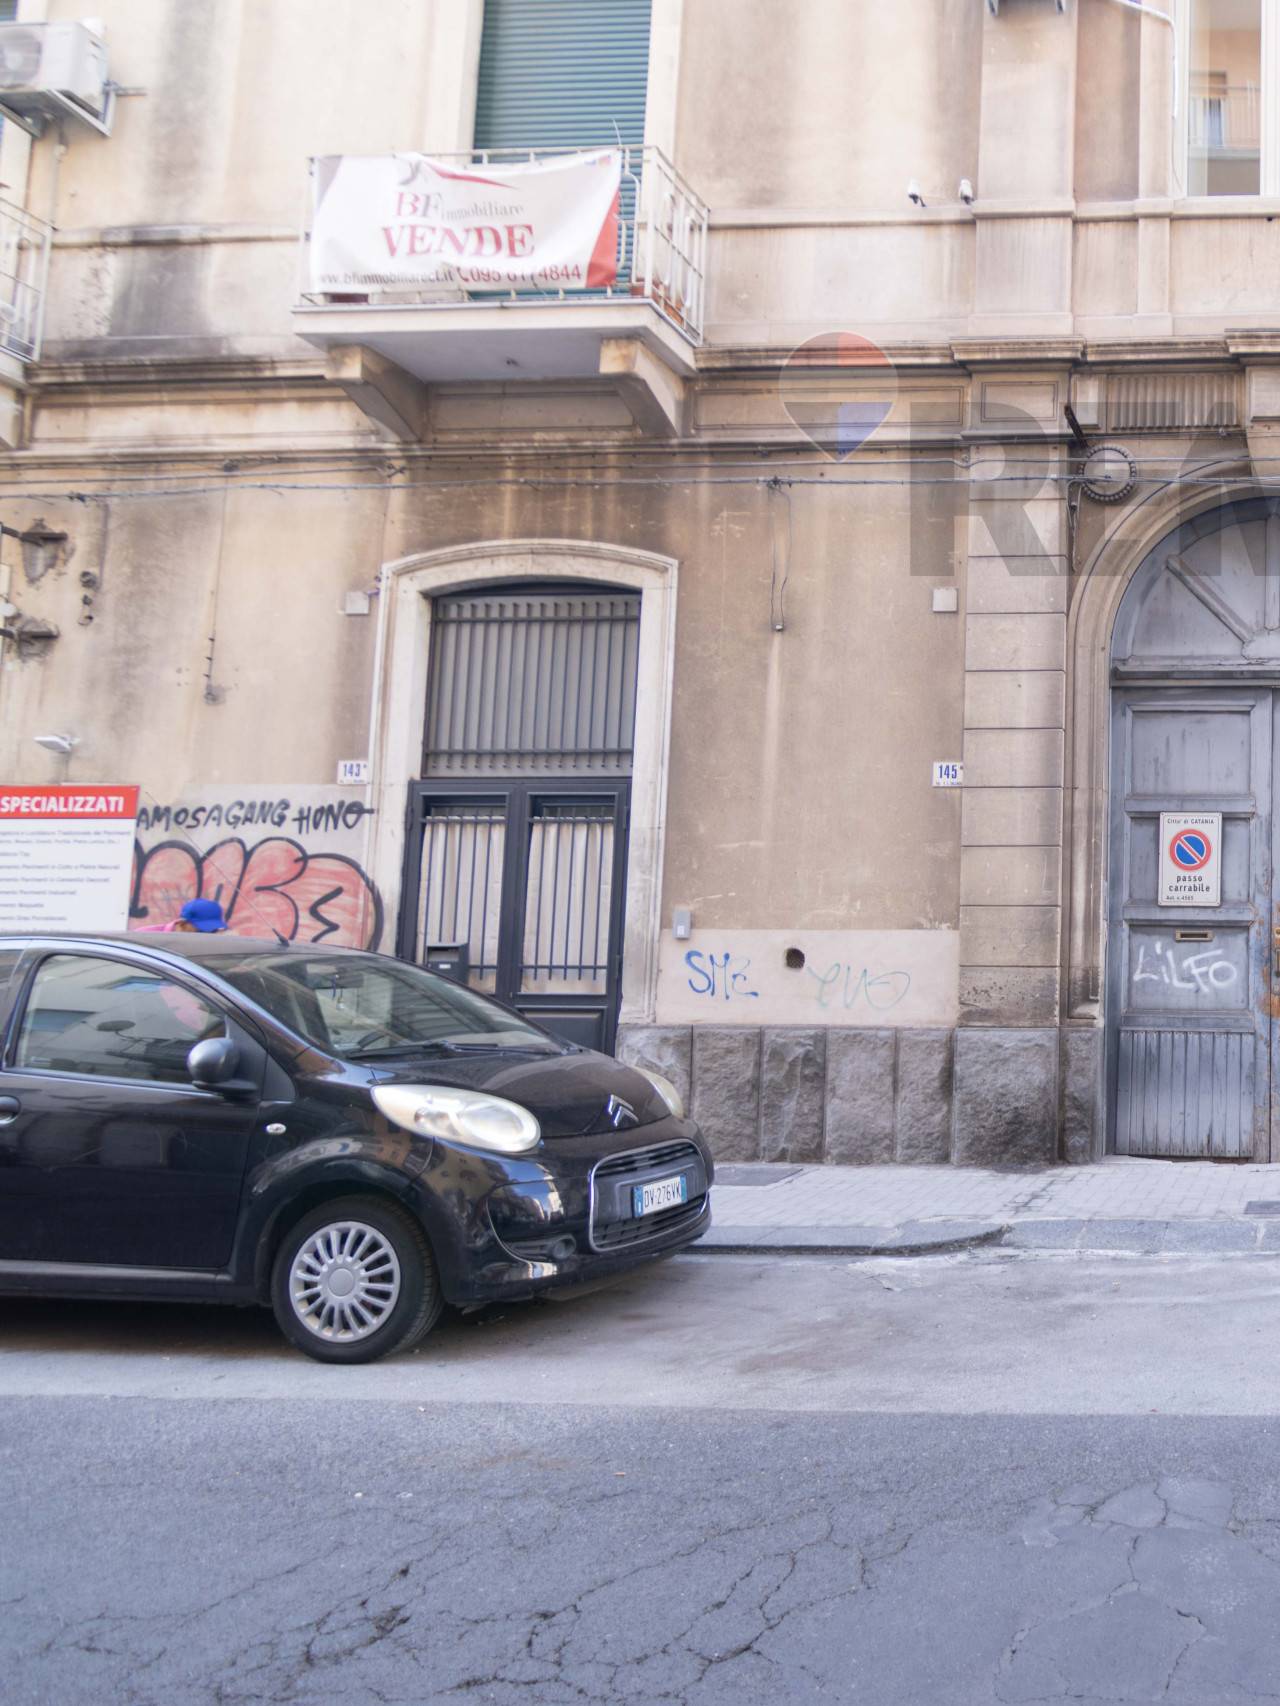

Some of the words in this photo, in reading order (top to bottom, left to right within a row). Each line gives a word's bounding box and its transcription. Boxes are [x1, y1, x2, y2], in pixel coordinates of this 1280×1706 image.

[396, 191, 441, 217] BF
[441, 200, 526, 222] immobiliare
[382, 223, 536, 258] VENDE
[344, 762, 361, 777] 143
[938, 763, 958, 779] 145
[0, 795, 125, 813] SPECIALIZZATI
[1168, 883, 1211, 892] carrabile
[1176, 875, 1203, 884] passo
